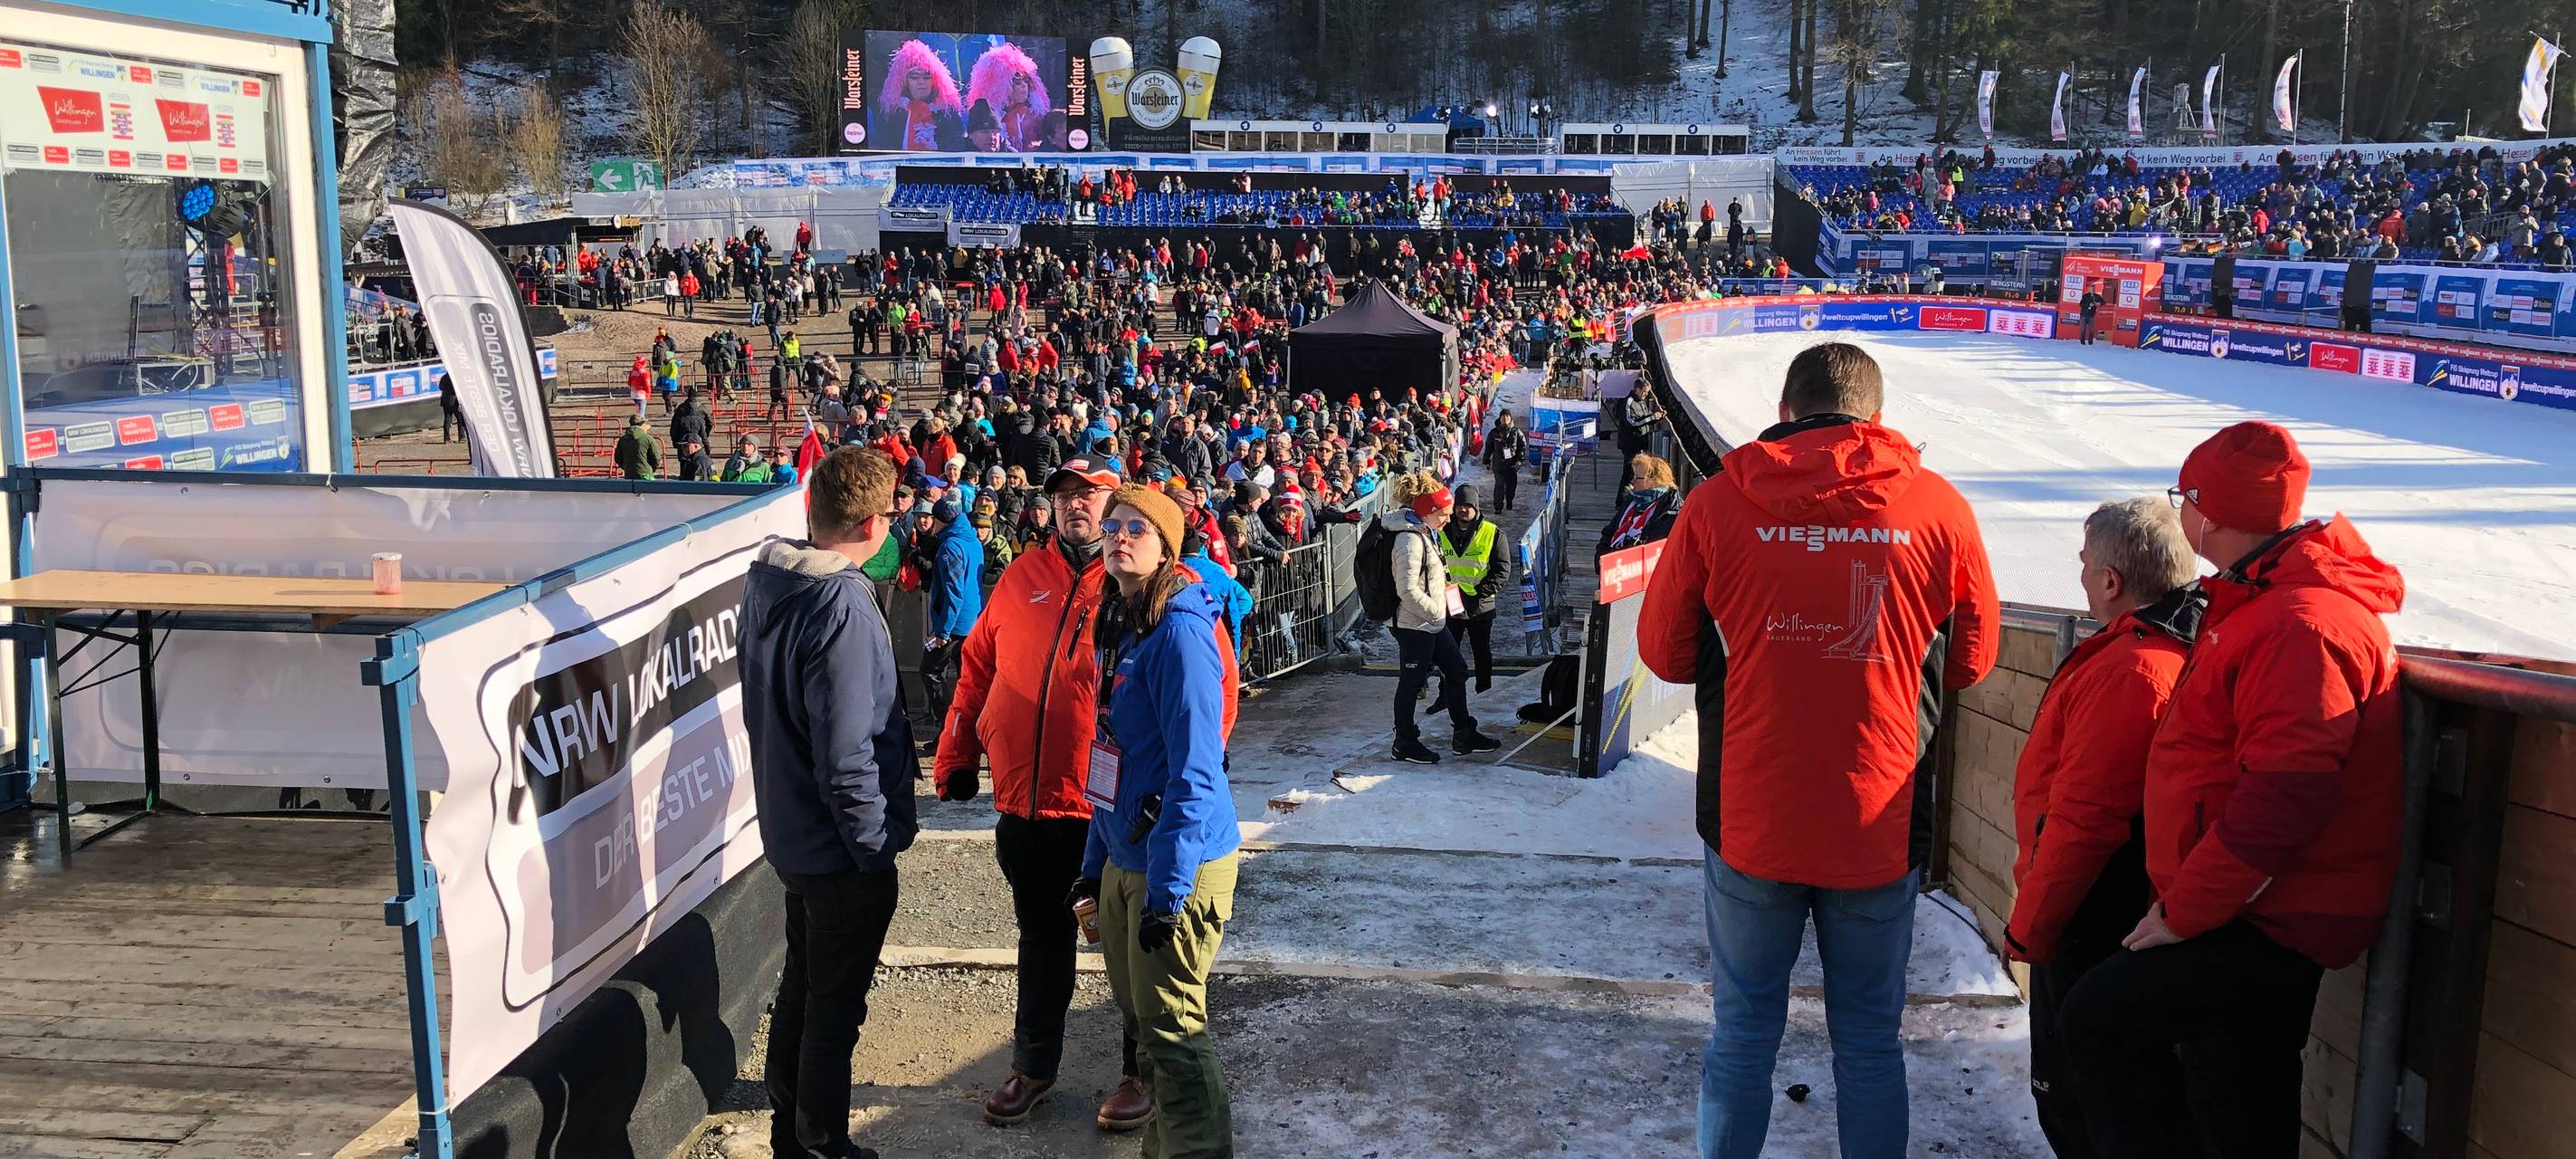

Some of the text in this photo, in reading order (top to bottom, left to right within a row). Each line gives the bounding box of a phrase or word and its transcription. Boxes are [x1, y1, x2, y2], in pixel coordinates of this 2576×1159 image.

[844, 48, 861, 109] Warsteiner
[1068, 56, 1085, 117] Warsteiner
[1131, 91, 1179, 108] Warsteiner
[54, 99, 97, 125] Willingen
[169, 110, 205, 135] Willingen
[2147, 152, 2168, 164] kein
[2171, 154, 2191, 166] Weg
[2257, 152, 2273, 163] An
[2100, 264, 2143, 276] VIESSMANN
[1990, 279, 2027, 289] BERGSTERN
[1743, 318, 1797, 328] WILLINGEN
[1821, 312, 1888, 322] #weltcupwillingen
[1935, 311, 1972, 326] Willingen
[2162, 337, 2209, 352] WILLINGEN
[2230, 342, 2285, 357] #weltcupwillingen
[2449, 374, 2498, 393] WILLINGEN
[235, 448, 278, 465] WILLINGEN
[1755, 524, 1911, 552] VIESSMANN
[1604, 558, 1644, 594] VIESSMANN
[1766, 612, 1844, 642] Willingen
[512, 603, 740, 789] NRW LOKALRAD
[594, 811, 635, 890] DER
[639, 756, 714, 845] BESTE
